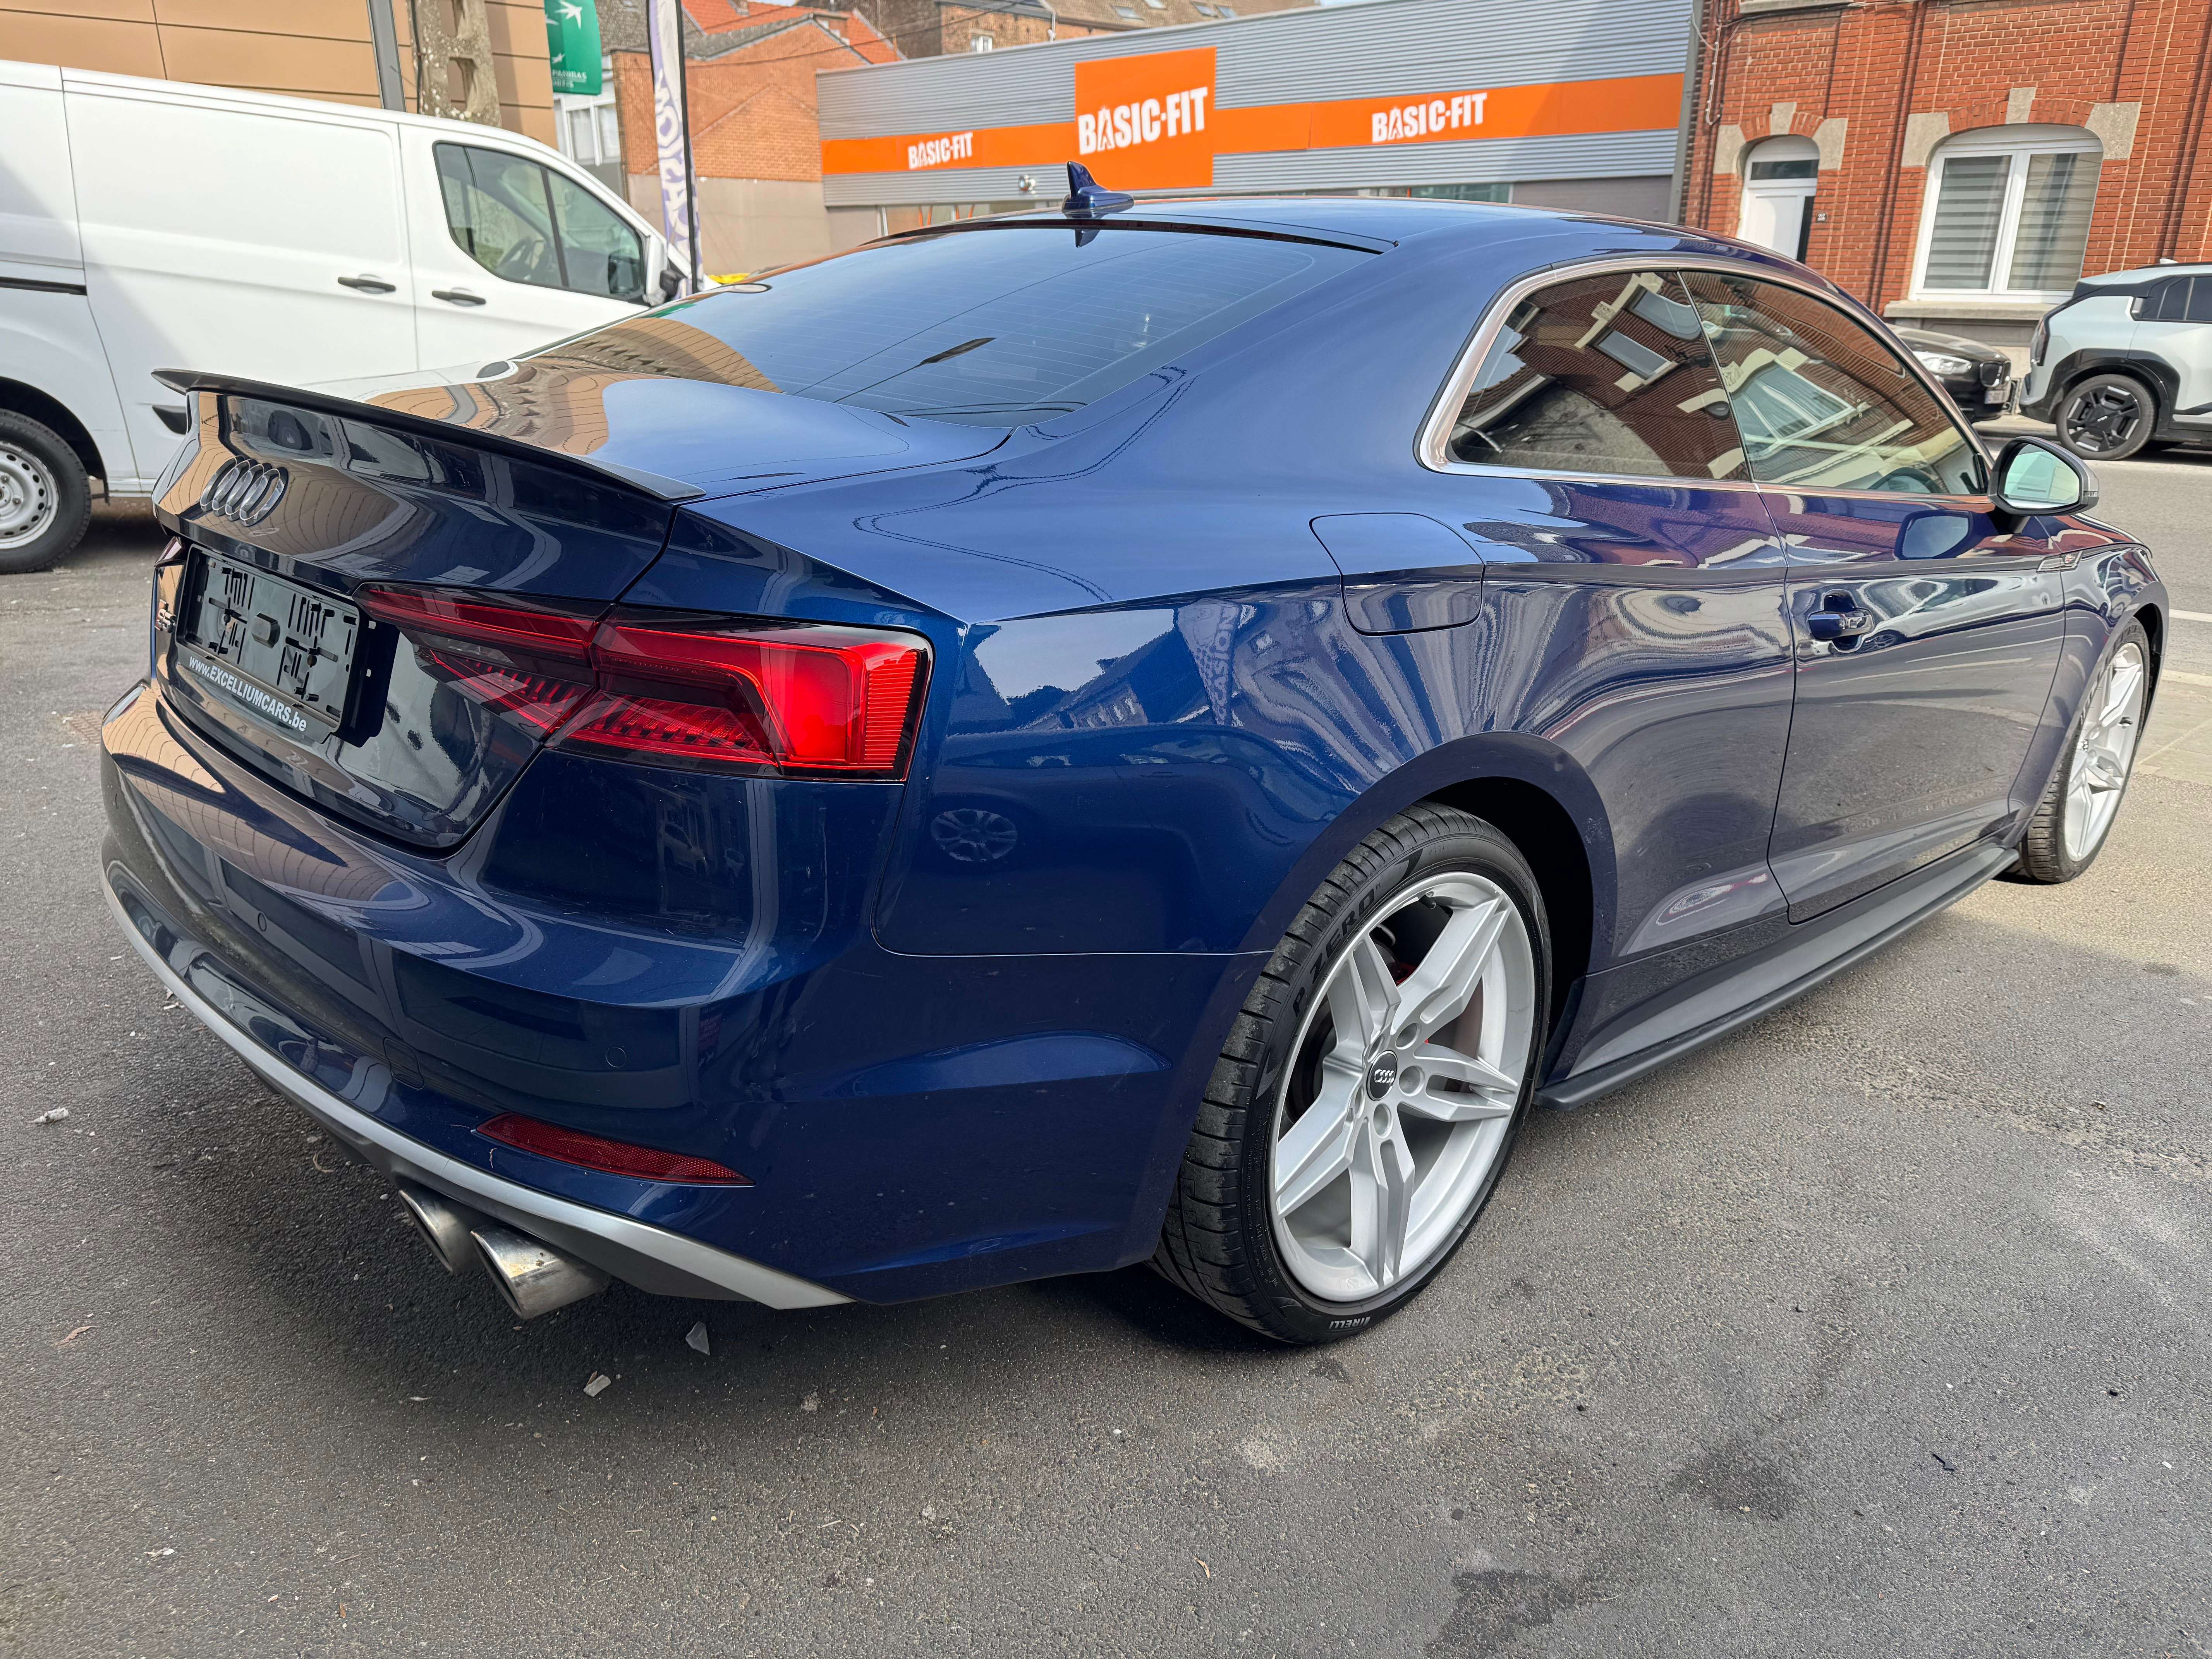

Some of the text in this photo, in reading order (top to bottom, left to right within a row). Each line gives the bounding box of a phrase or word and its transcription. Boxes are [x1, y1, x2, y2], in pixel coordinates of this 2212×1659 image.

[1078, 86, 1208, 155] BASIC-FIT
[1372, 92, 1487, 143] BASIC-FIT
[908, 132, 973, 169] BASIC-FIT
[189, 656, 307, 732] www.EXCELLIUMCARS.be
